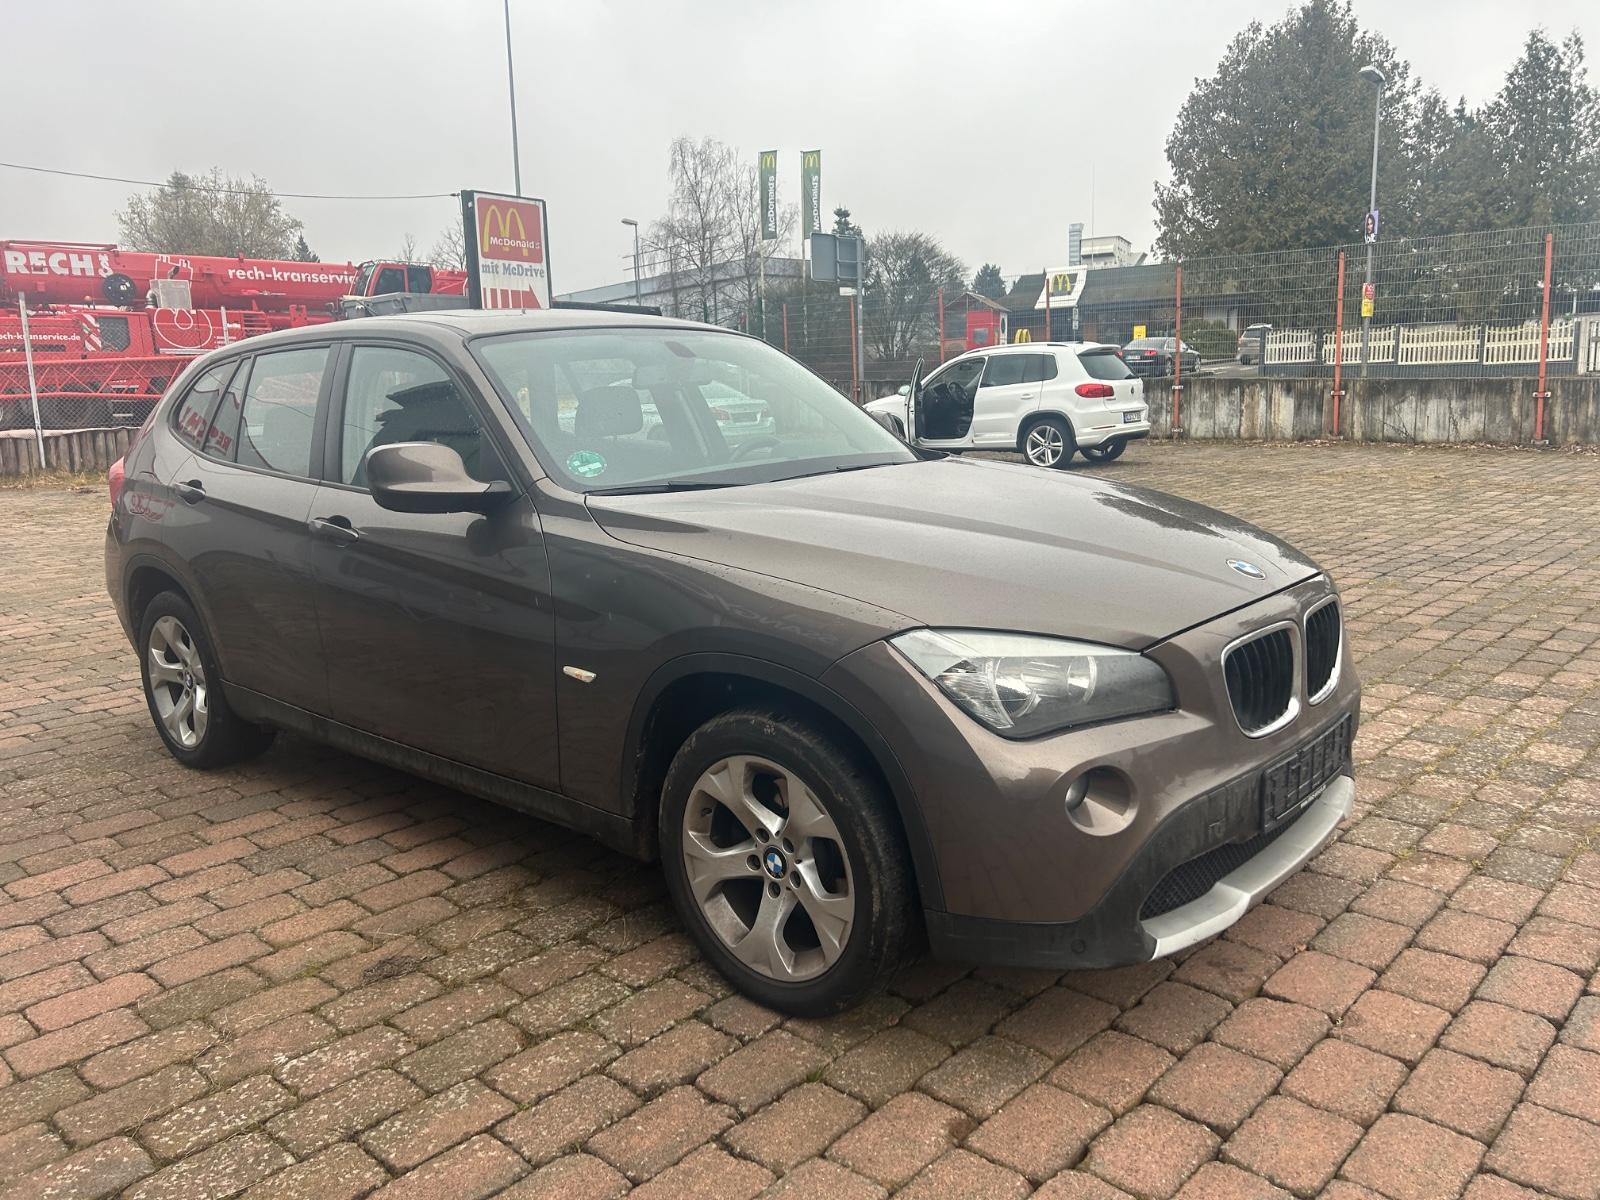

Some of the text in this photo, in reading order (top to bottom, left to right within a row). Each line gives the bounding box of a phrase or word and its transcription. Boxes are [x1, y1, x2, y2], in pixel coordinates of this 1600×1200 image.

[490, 236, 541, 249] McDonalds
[4, 250, 95, 276] RECH
[481, 262, 545, 278] mit McDrive
[228, 266, 359, 285] rech-kranservic
[0, 330, 81, 341] ch-kanservice.de
